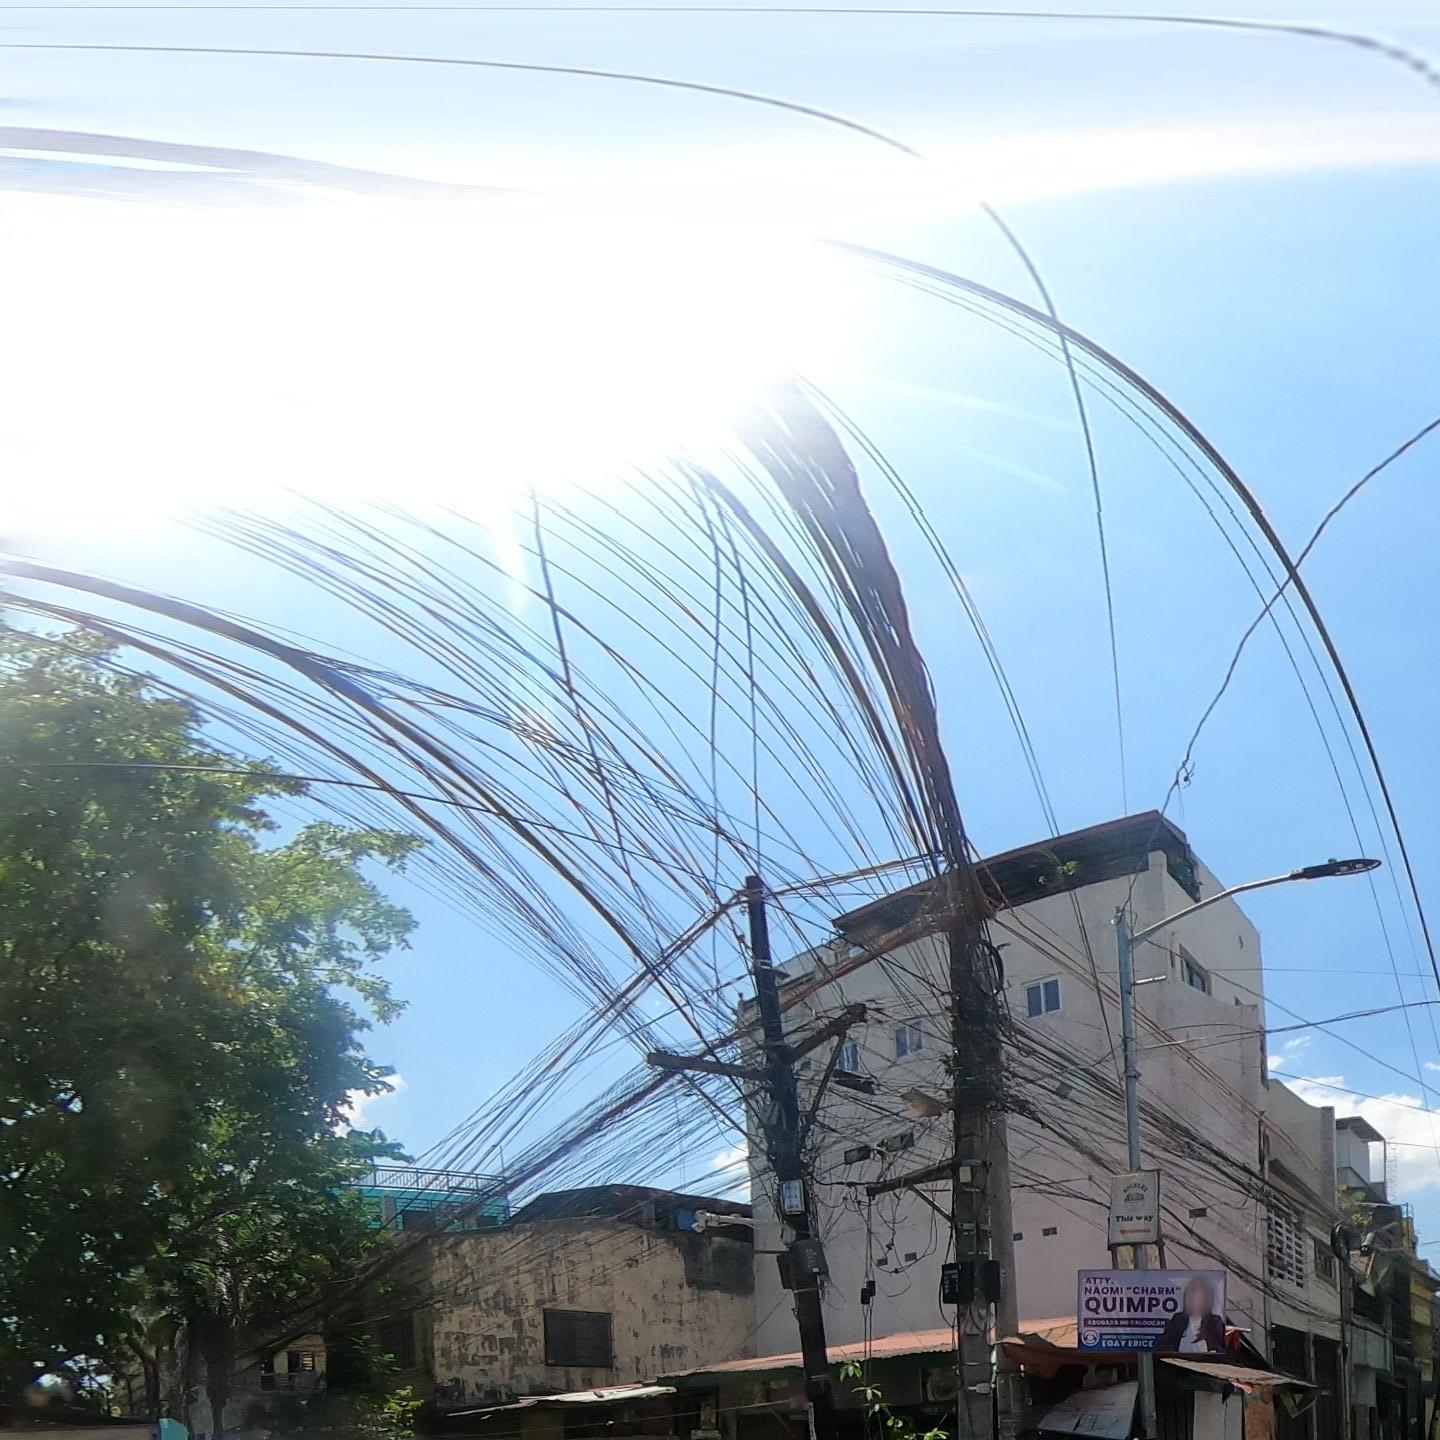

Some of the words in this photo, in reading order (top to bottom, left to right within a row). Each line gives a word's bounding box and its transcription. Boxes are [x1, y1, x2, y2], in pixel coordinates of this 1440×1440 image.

[1085, 1277, 1114, 1285] ATTY.
[1084, 1286, 1123, 1295] NAOMI
[1085, 1296, 1179, 1315] QUIMPO
